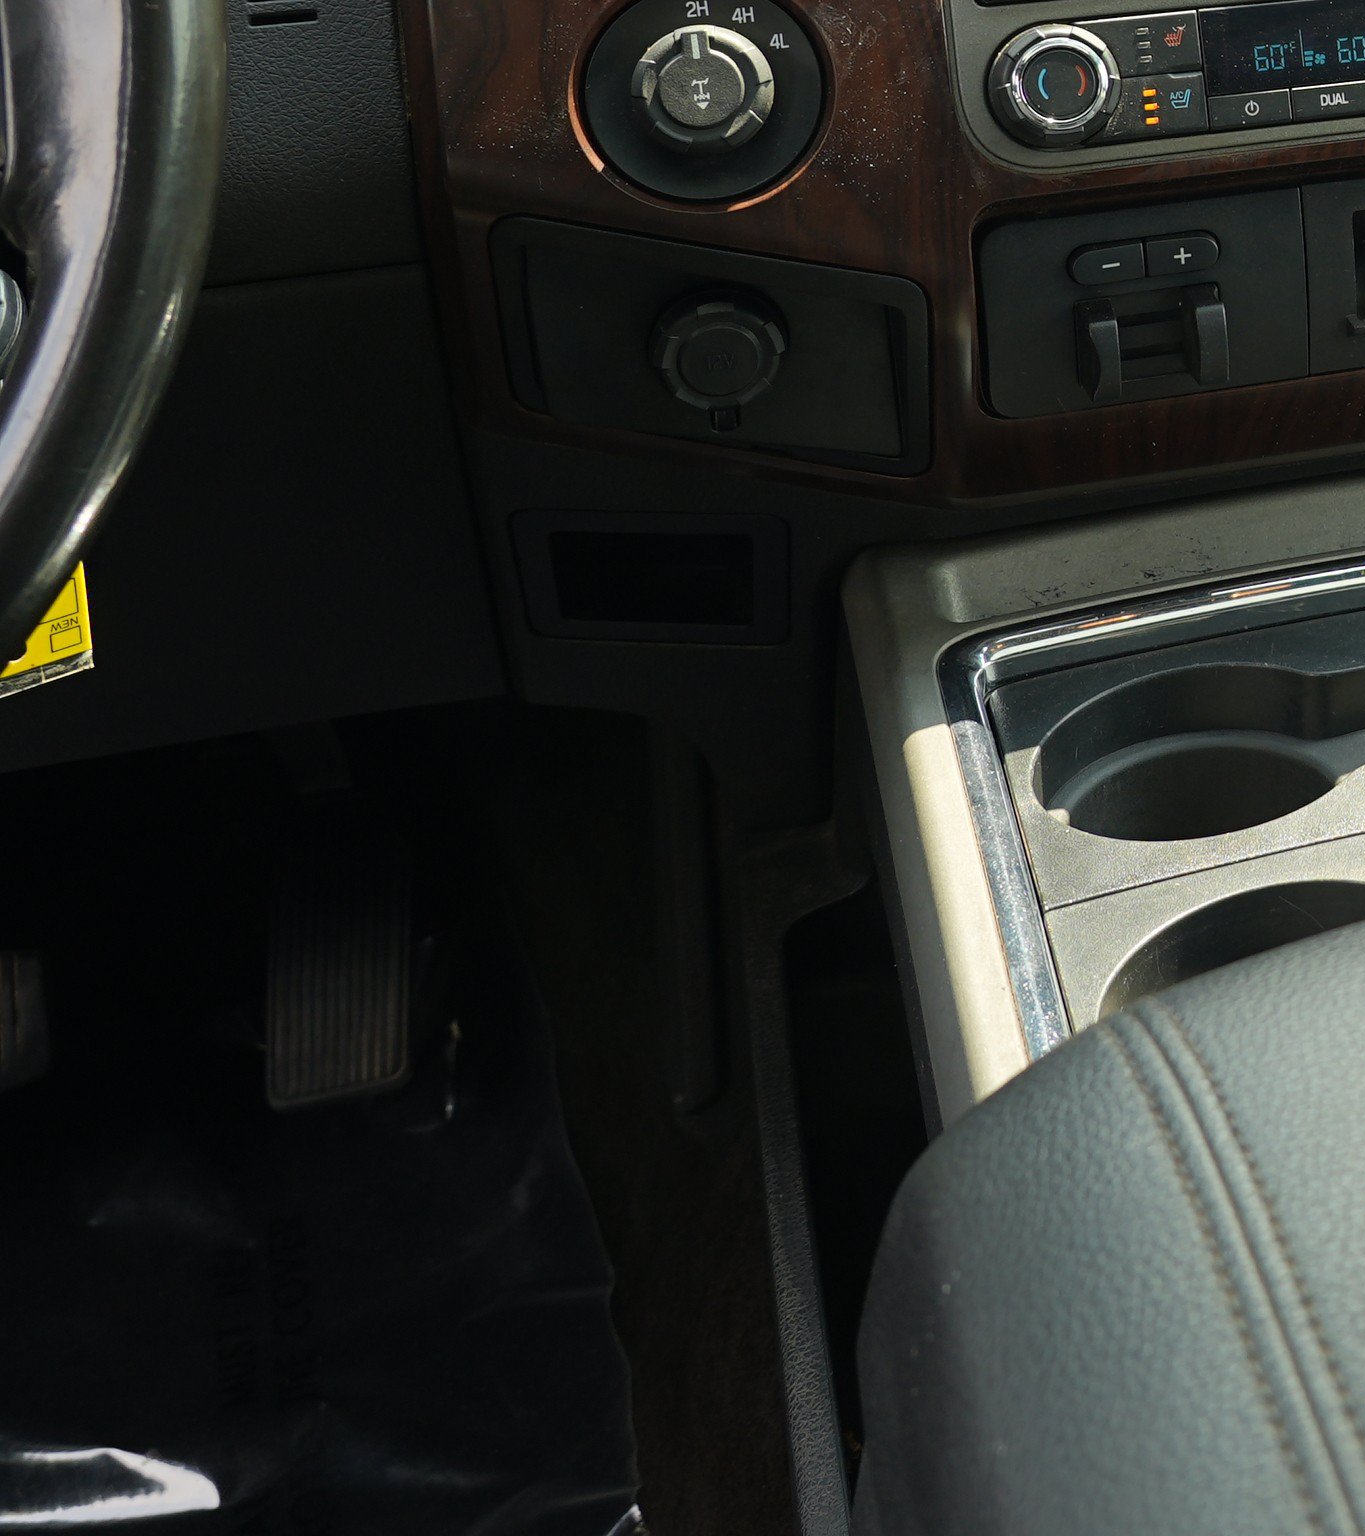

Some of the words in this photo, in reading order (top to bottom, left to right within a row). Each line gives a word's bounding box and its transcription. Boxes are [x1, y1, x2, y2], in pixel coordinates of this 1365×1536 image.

[685, 0, 710, 18] 2H
[731, 6, 755, 24] 4H
[769, 33, 789, 50] 4L
[1169, 90, 1184, 101] A/C
[1319, 93, 1349, 107] DUAL
[50, 616, 79, 633] NEW
